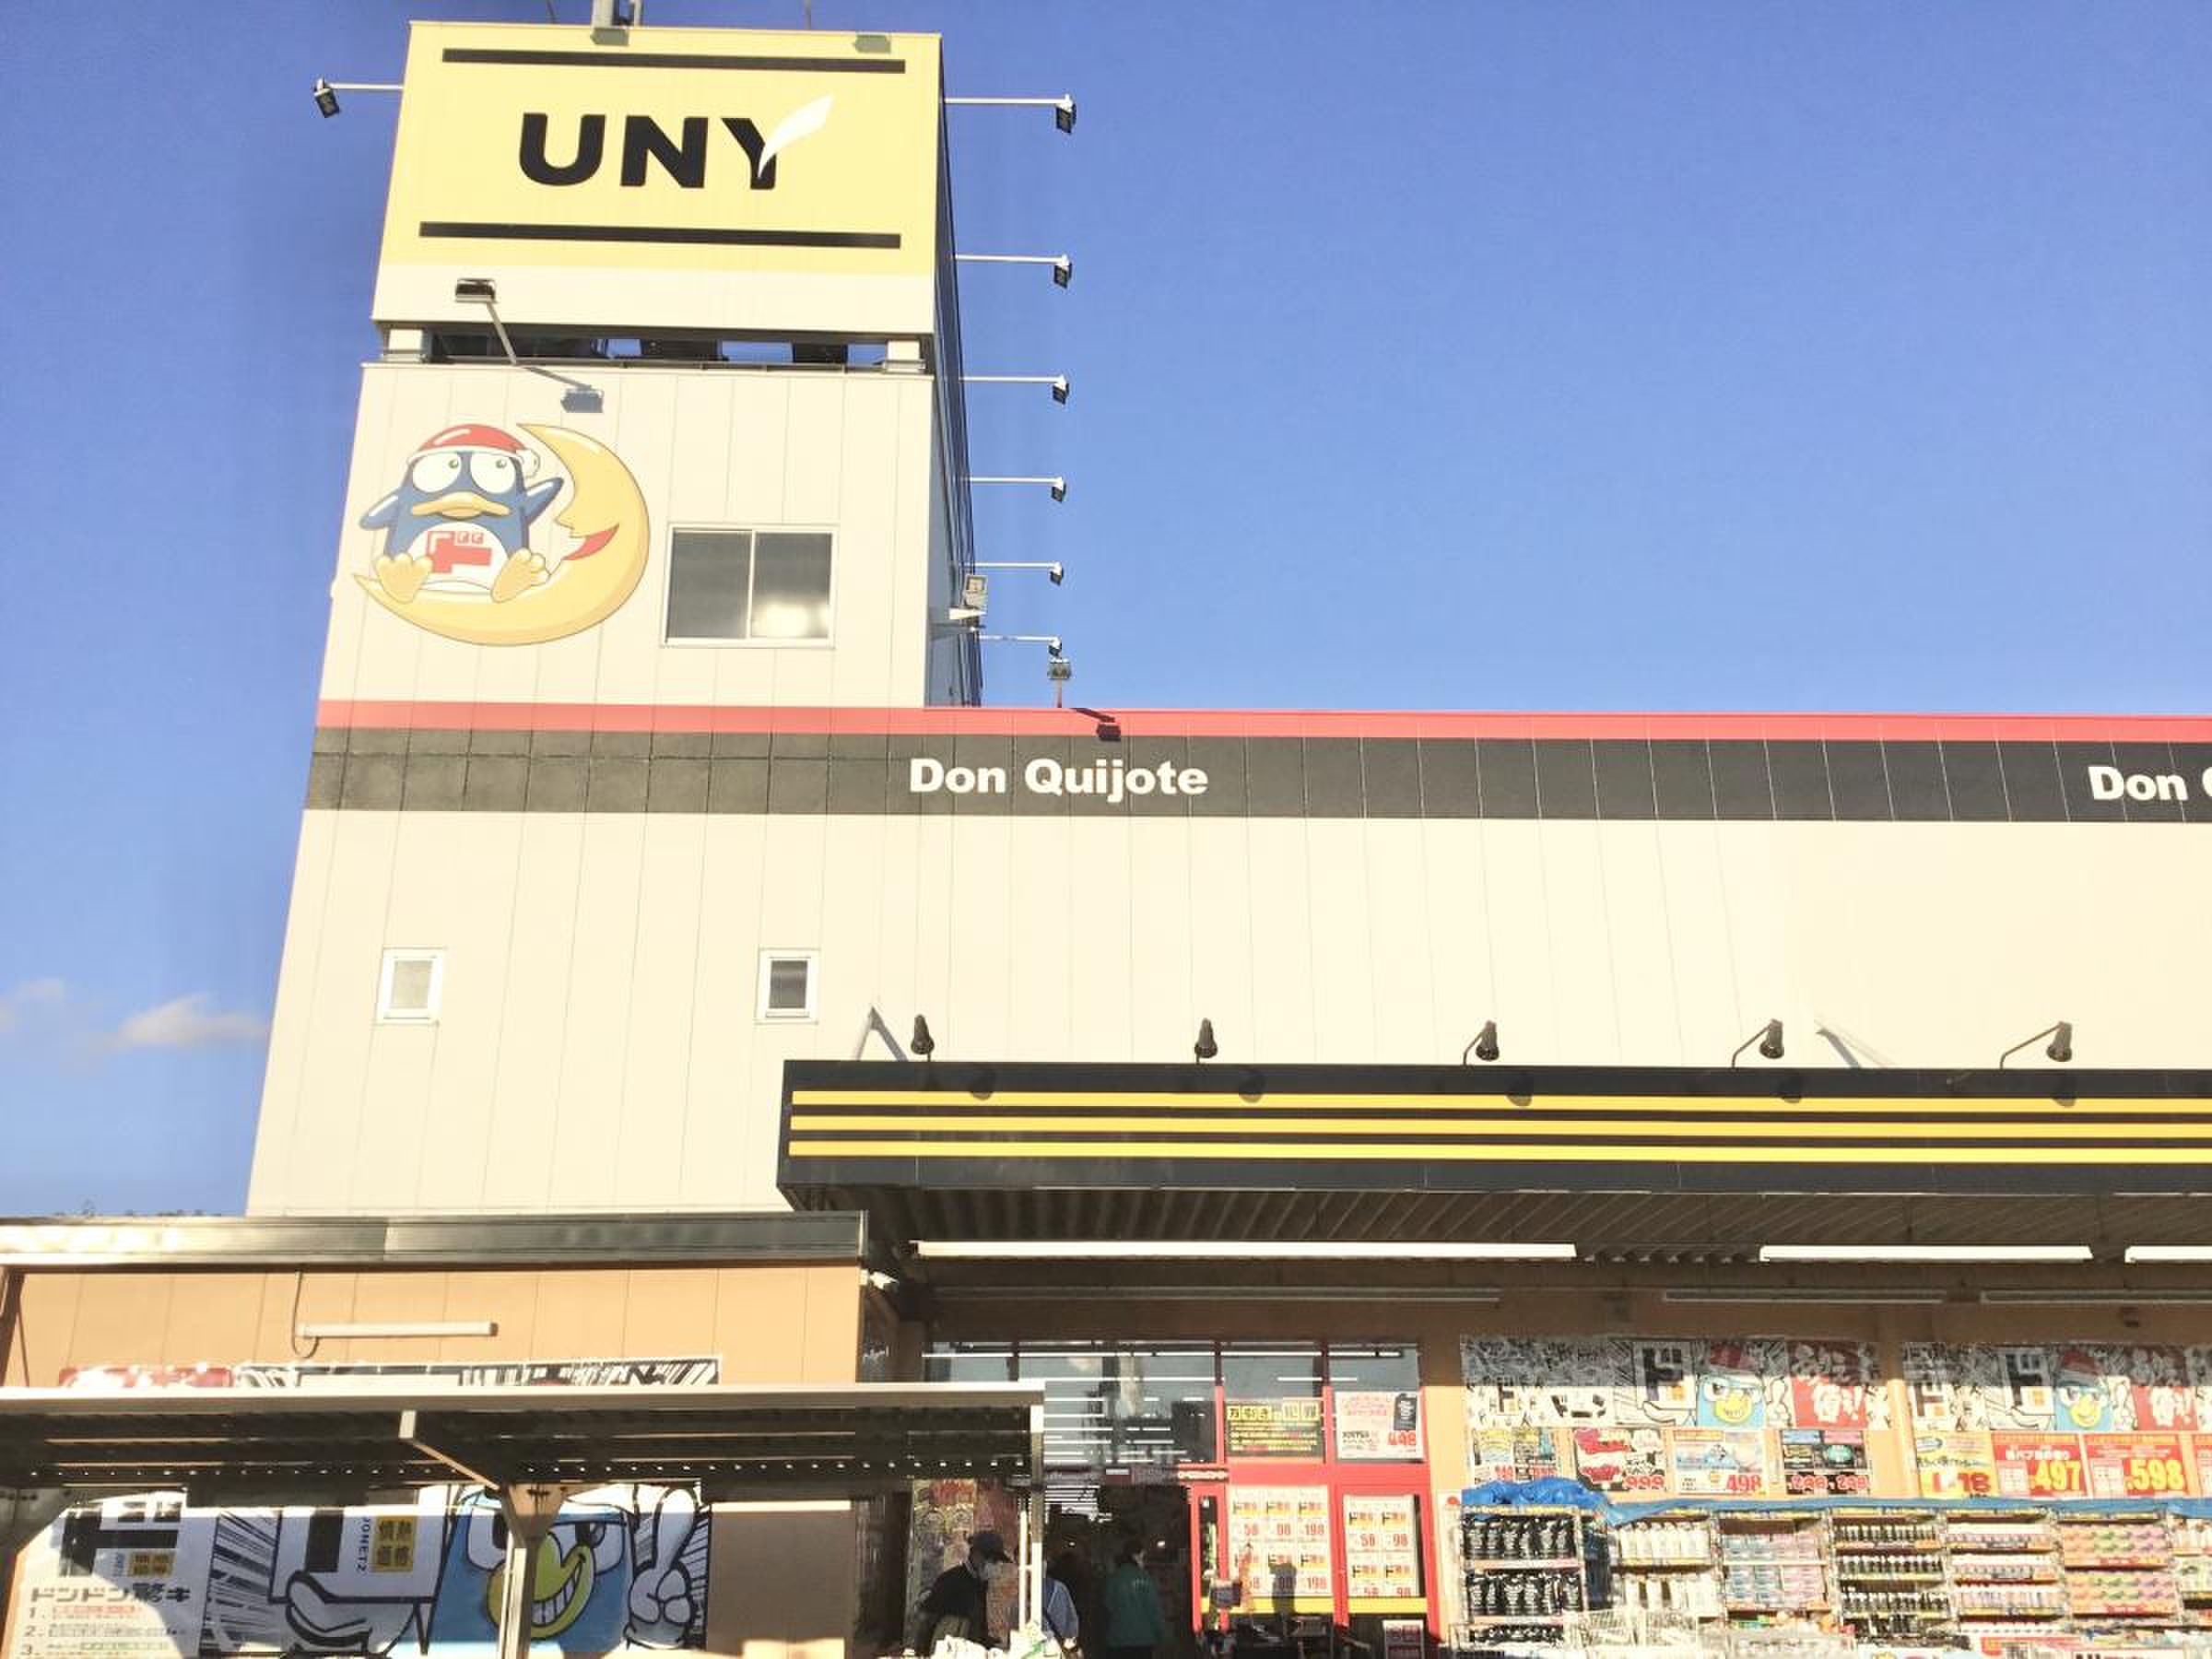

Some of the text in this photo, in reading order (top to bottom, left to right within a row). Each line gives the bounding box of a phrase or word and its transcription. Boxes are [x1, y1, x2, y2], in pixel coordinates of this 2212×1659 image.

[519, 94, 833, 190] UNY
[910, 759, 1209, 803] Don Quijote
[2088, 766, 2189, 801] Don
[1726, 1475, 1763, 1491] 498
[2034, 1460, 2080, 1490] 497
[2129, 1460, 2183, 1489] 598
